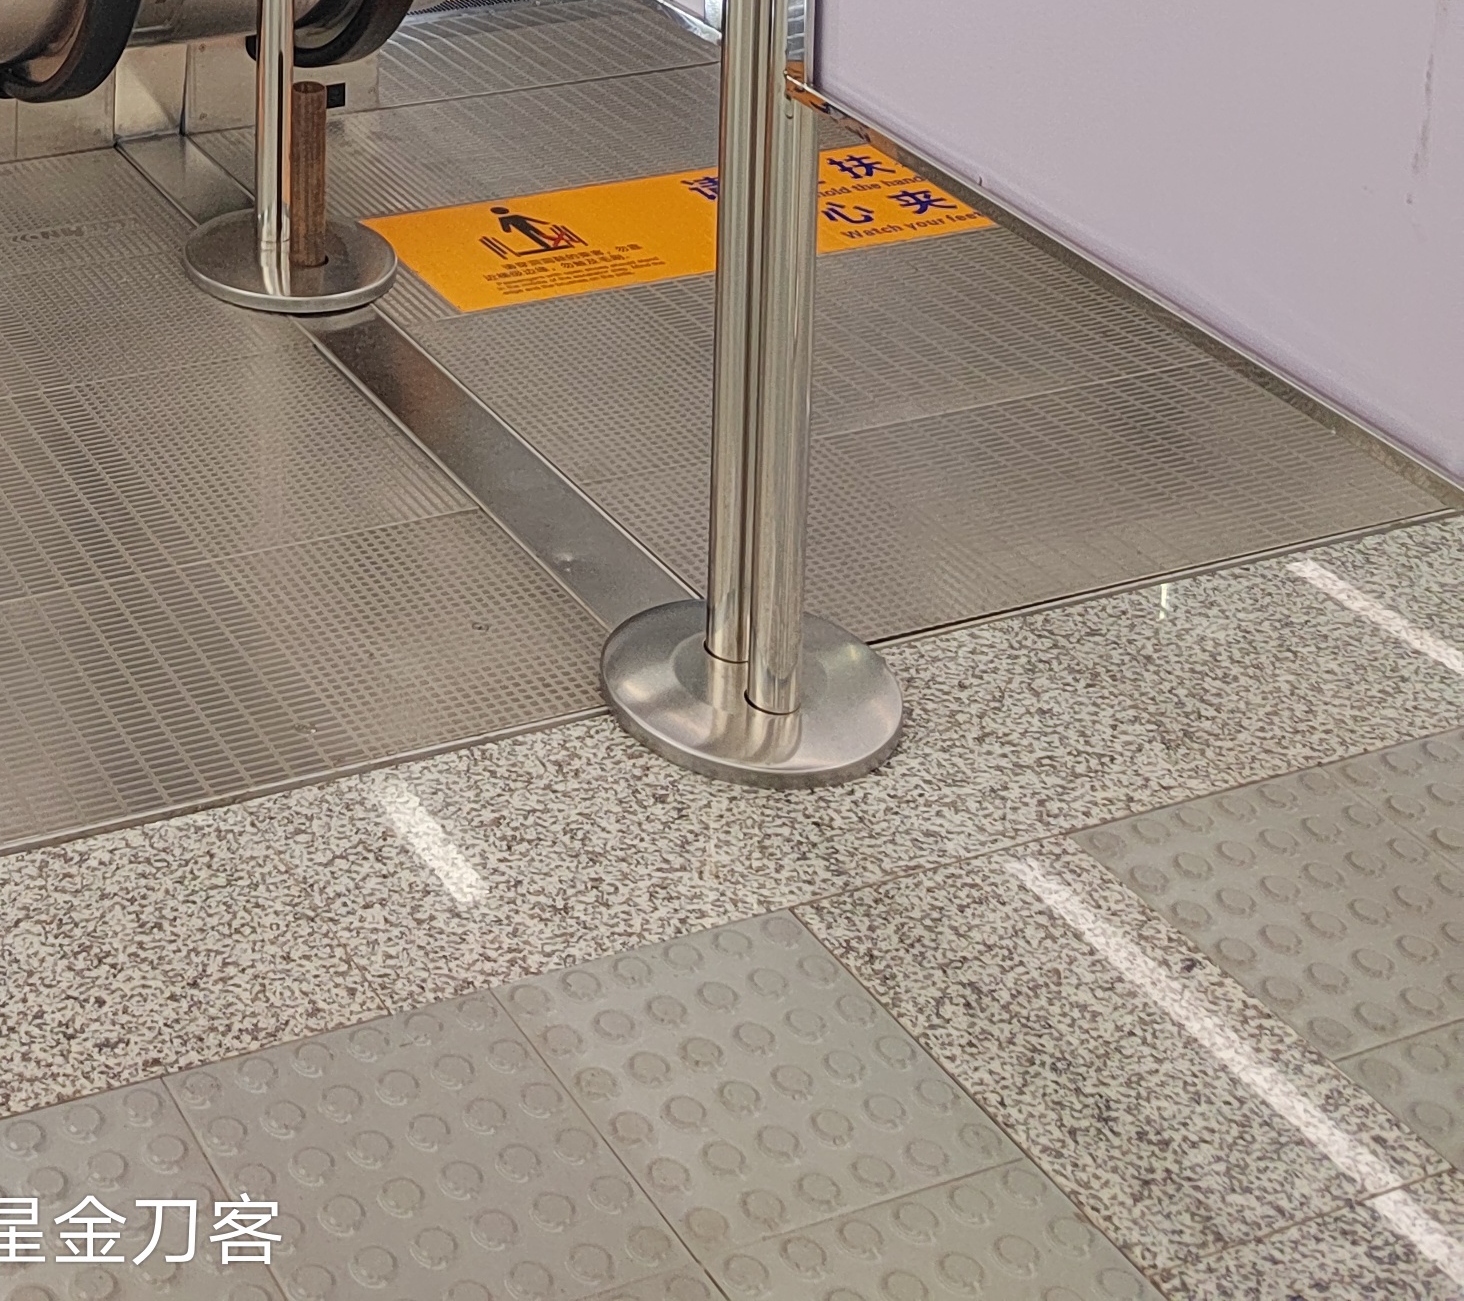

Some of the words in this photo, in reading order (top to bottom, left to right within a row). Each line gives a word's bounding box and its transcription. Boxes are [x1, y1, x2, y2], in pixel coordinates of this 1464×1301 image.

[852, 181, 881, 193] the
[840, 224, 902, 240] Watch
[904, 217, 946, 231] your
